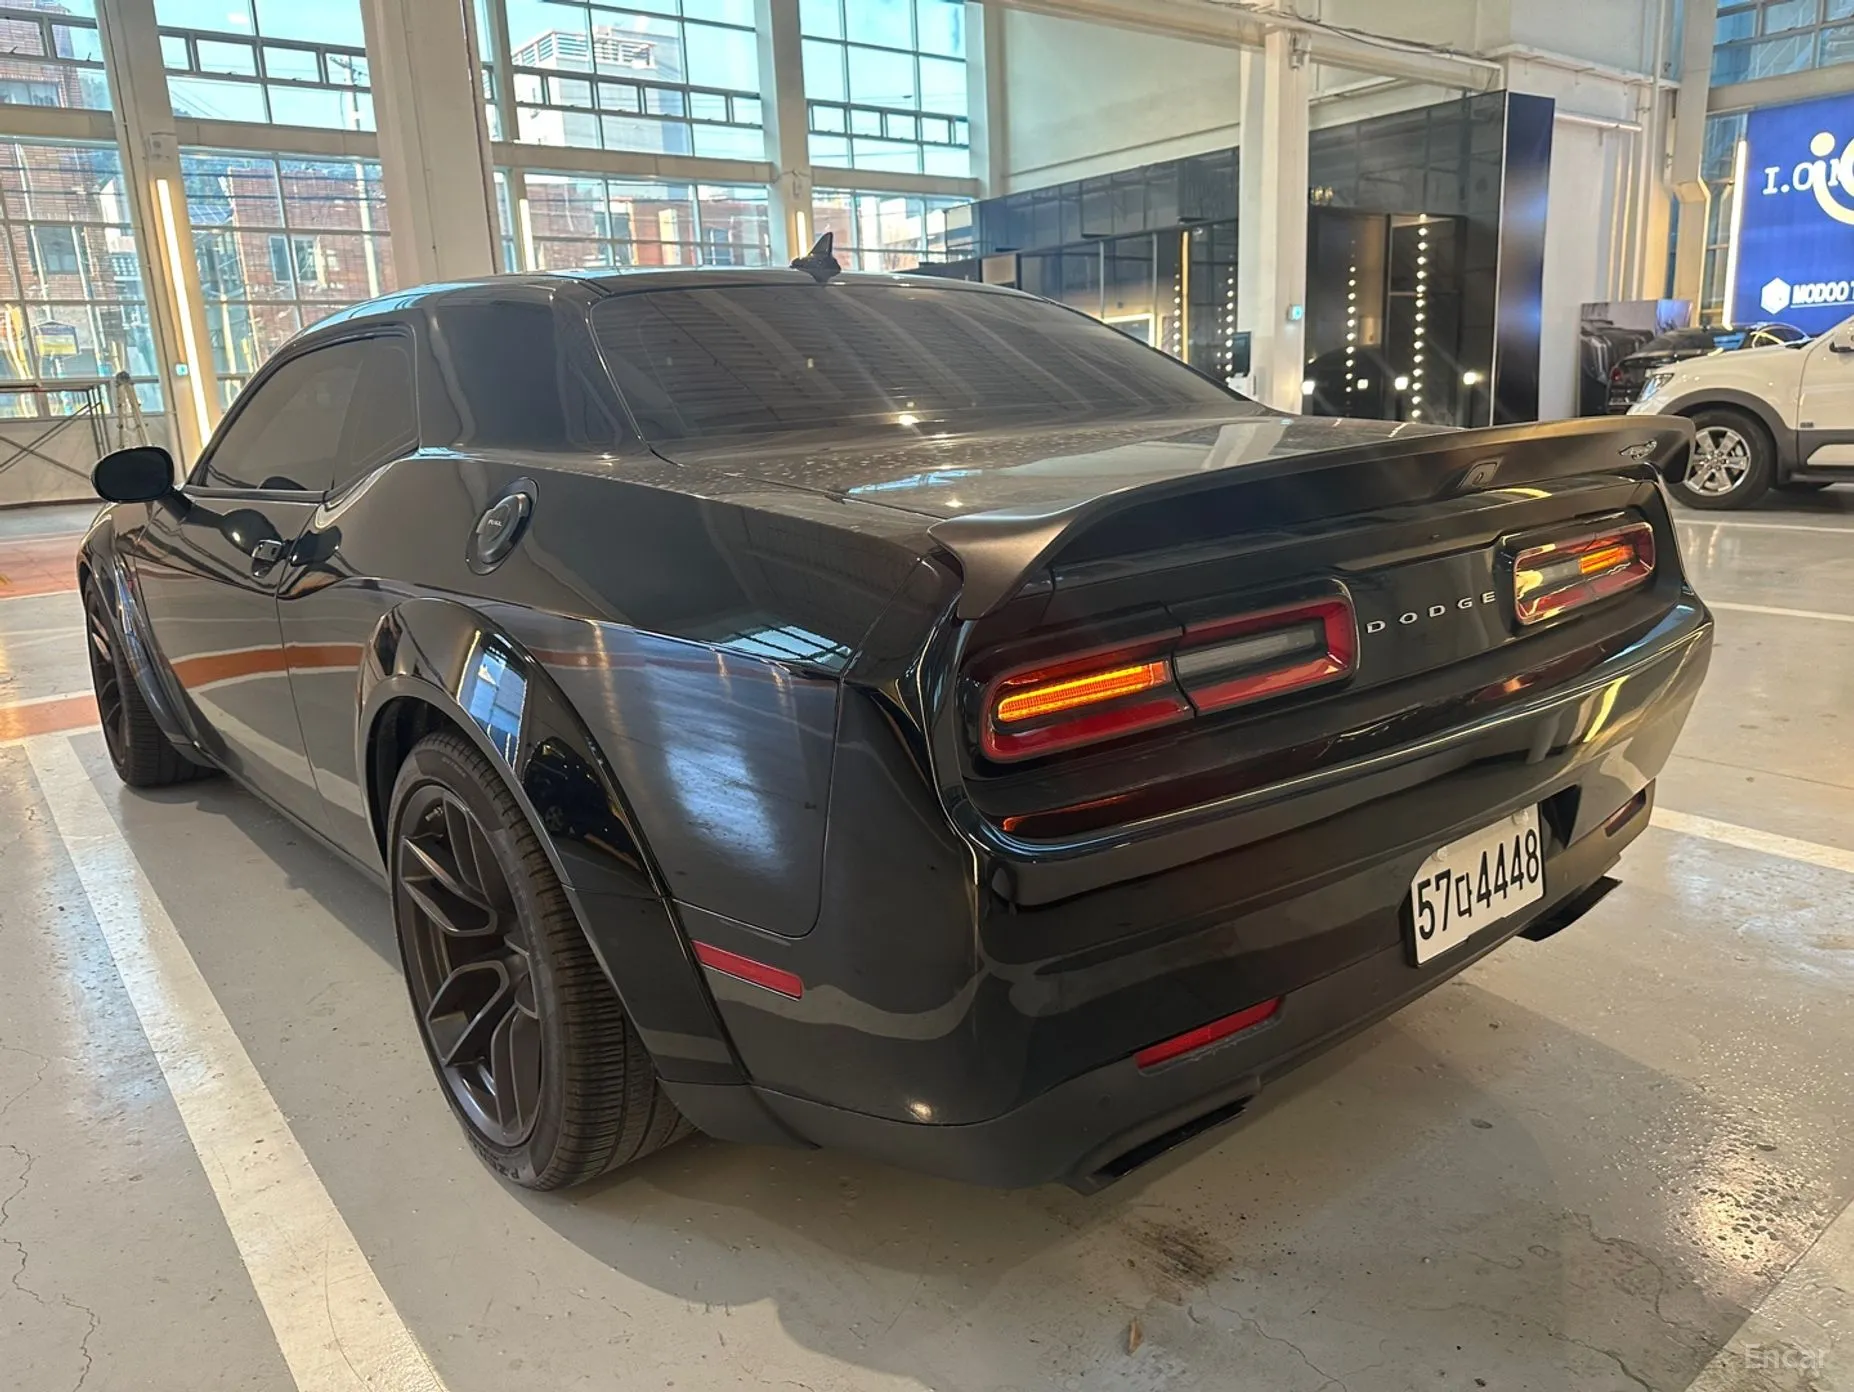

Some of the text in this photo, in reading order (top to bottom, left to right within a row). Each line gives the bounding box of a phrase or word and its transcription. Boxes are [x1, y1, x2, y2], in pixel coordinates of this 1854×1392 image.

[1791, 281, 1850, 304] MODOO
[1366, 591, 1496, 633] DODGE
[1417, 828, 1540, 940] 57마4448
